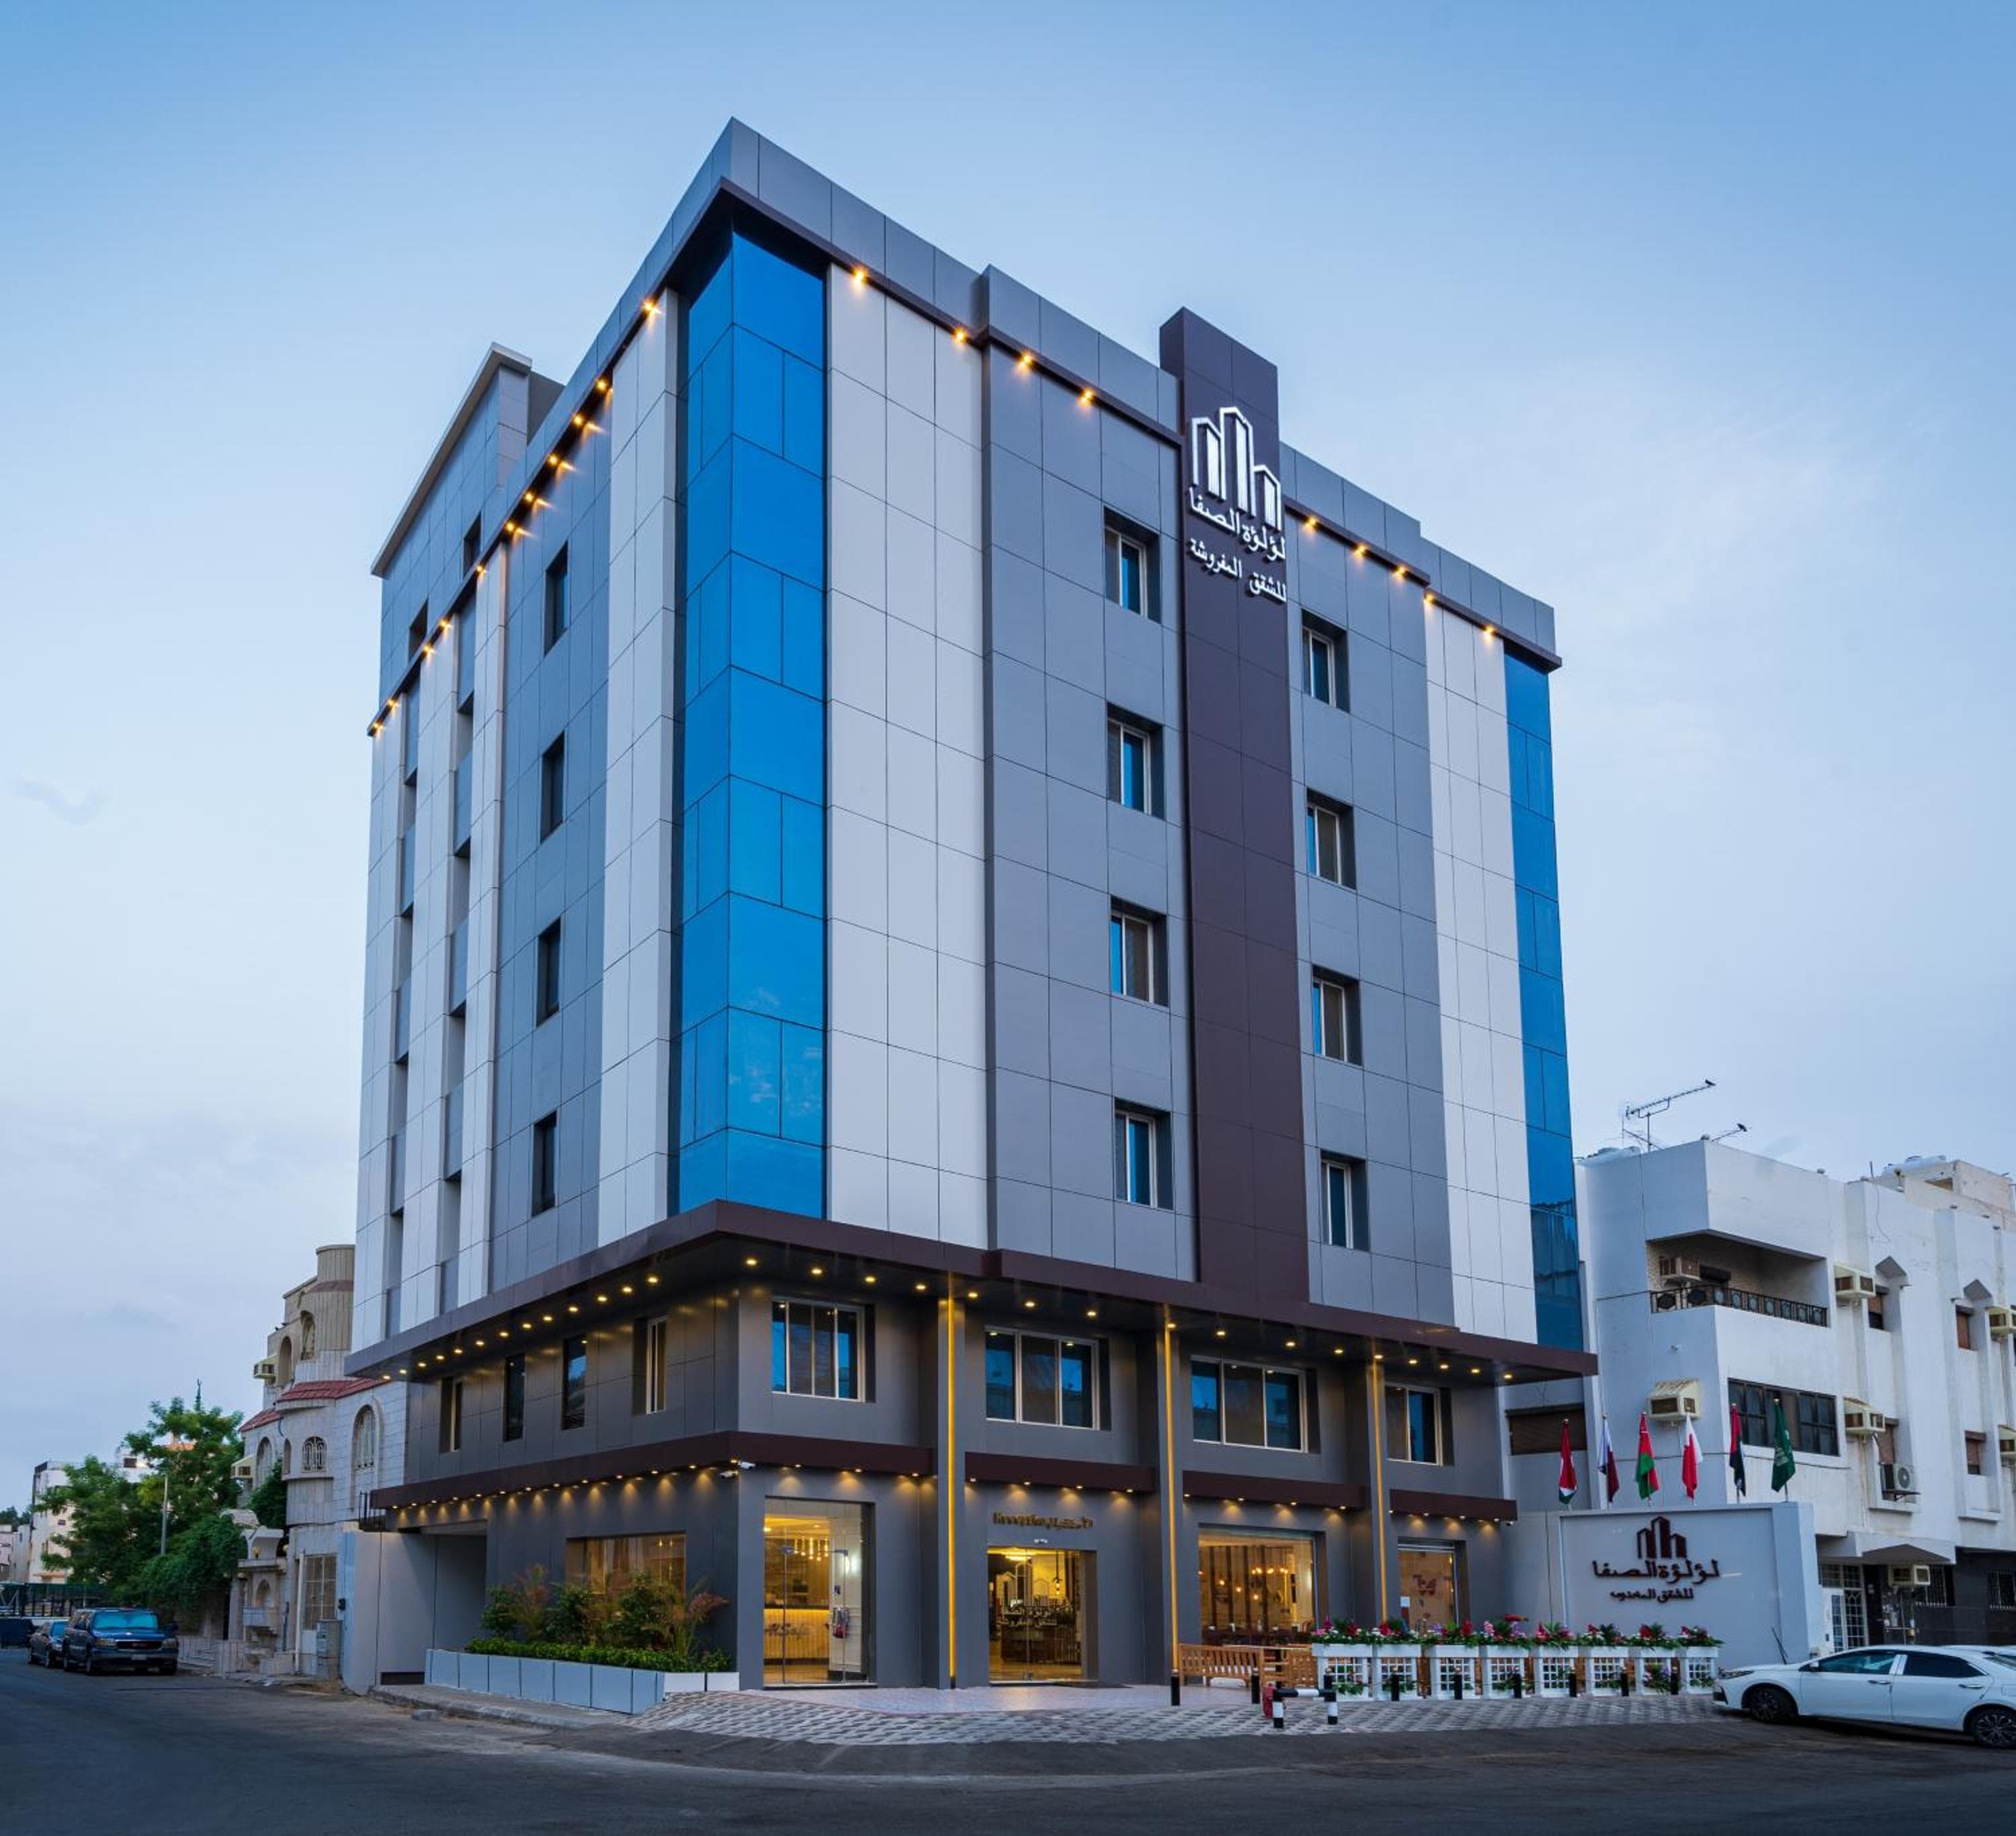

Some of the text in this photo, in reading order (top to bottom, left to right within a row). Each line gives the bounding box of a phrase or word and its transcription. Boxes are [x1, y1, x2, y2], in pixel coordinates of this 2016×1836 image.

[1189, 487, 1286, 561] لؤلؤة الصفا
[1189, 538, 1287, 603] للشقق المفروشة
[1591, 1558, 1720, 1585] لؤلؤة الصفا
